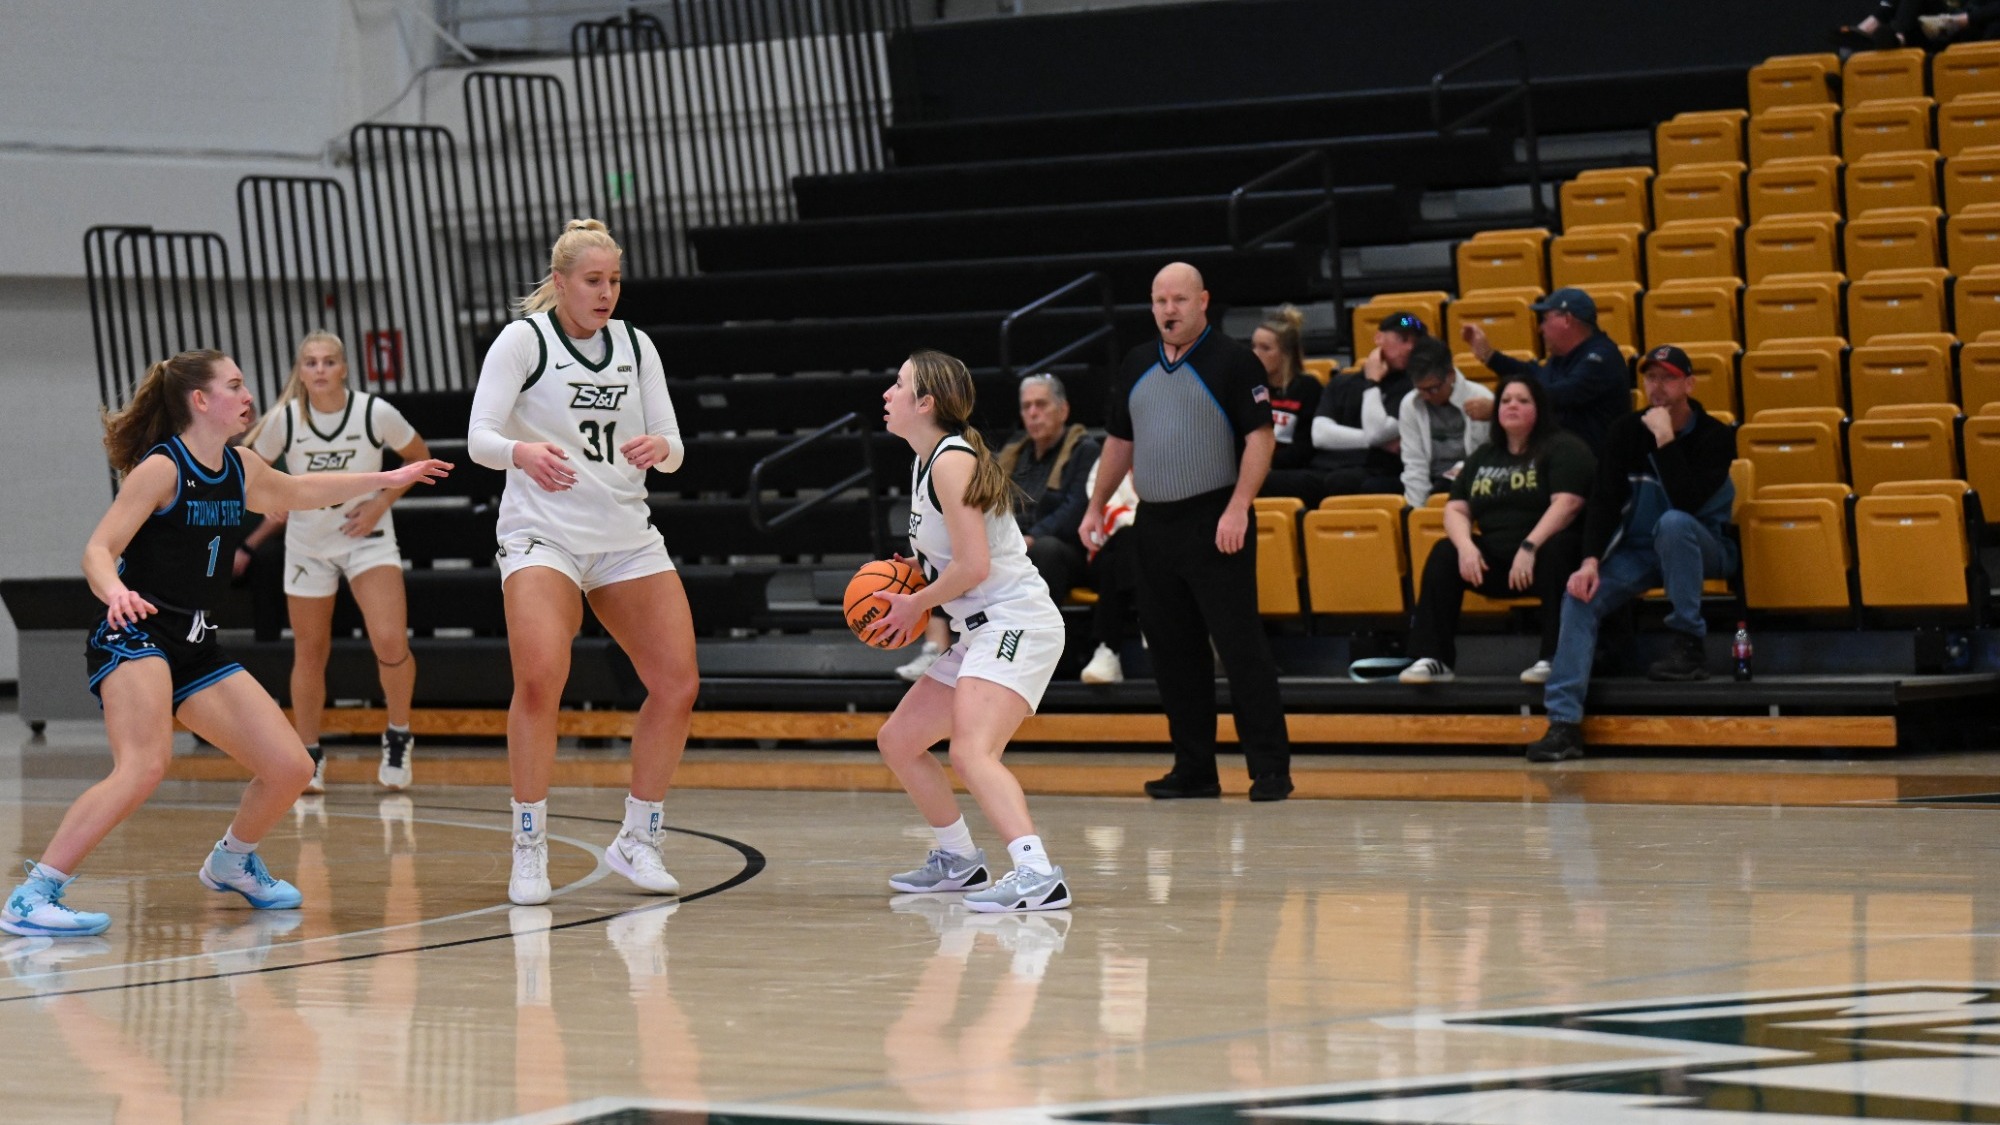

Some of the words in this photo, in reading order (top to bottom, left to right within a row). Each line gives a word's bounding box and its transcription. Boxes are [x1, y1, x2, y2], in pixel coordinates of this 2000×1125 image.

[568, 383, 628, 411] S&T
[579, 420, 616, 465] 31
[206, 535, 221, 577] 1
[850, 606, 880, 634] ilson
